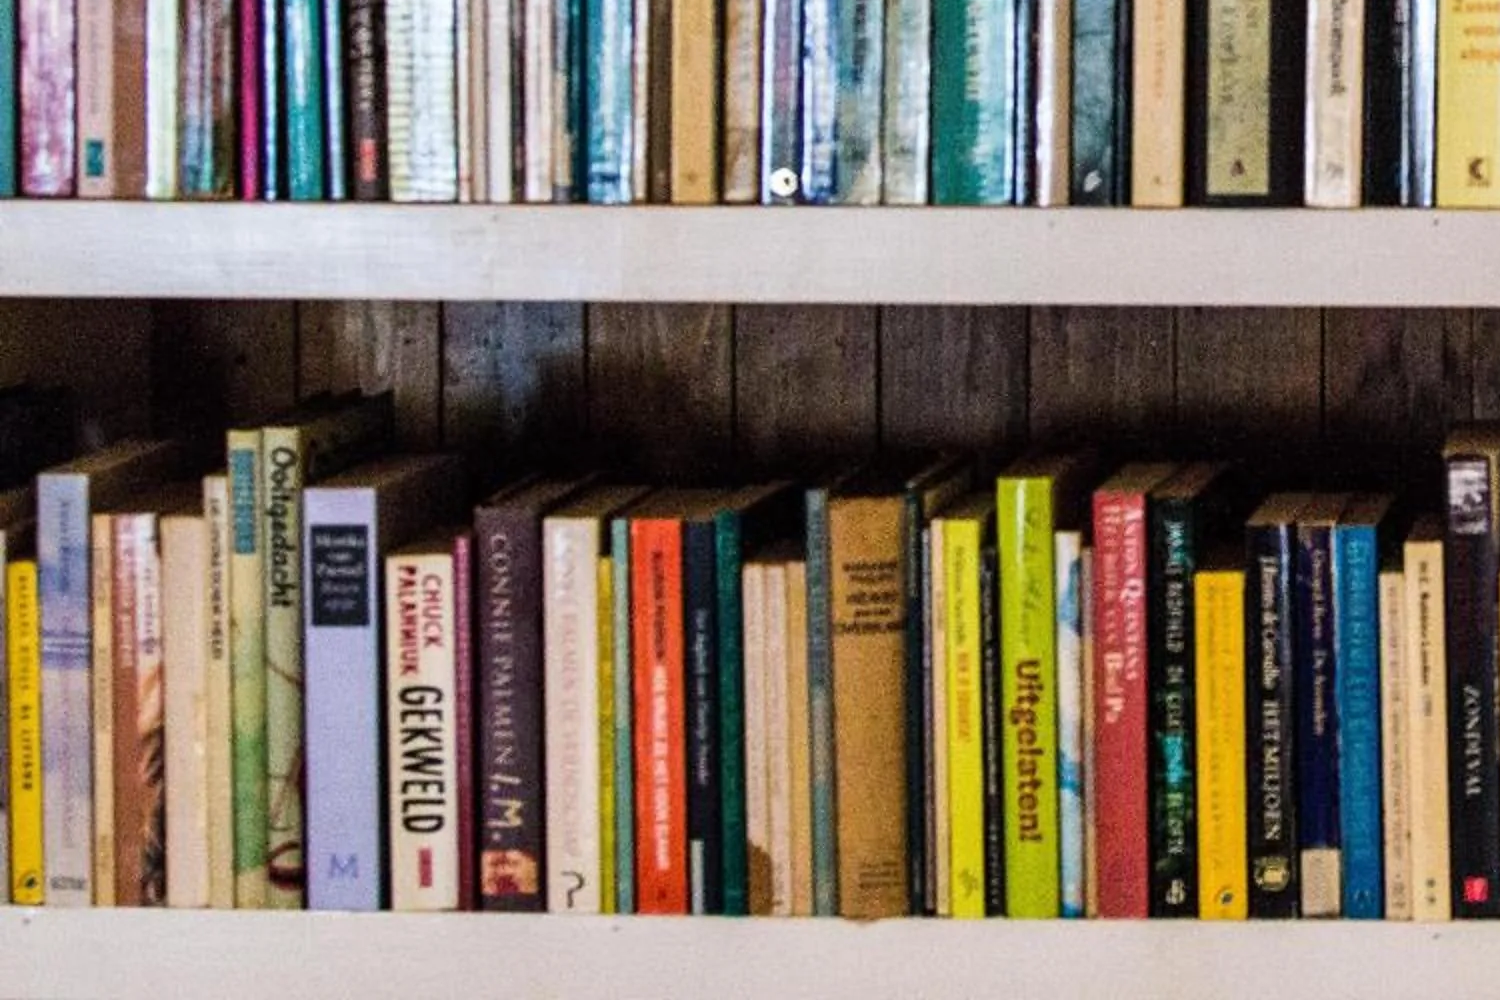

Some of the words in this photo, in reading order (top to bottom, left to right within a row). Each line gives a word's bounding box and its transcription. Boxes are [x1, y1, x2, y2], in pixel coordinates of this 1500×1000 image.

[422, 575, 444, 648] CHUCK
[488, 534, 514, 647] CONNIE
[398, 688, 444, 834] GEKWELD
[490, 654, 514, 765] PALMEN
[1014, 660, 1045, 845] Uitgelaten!
